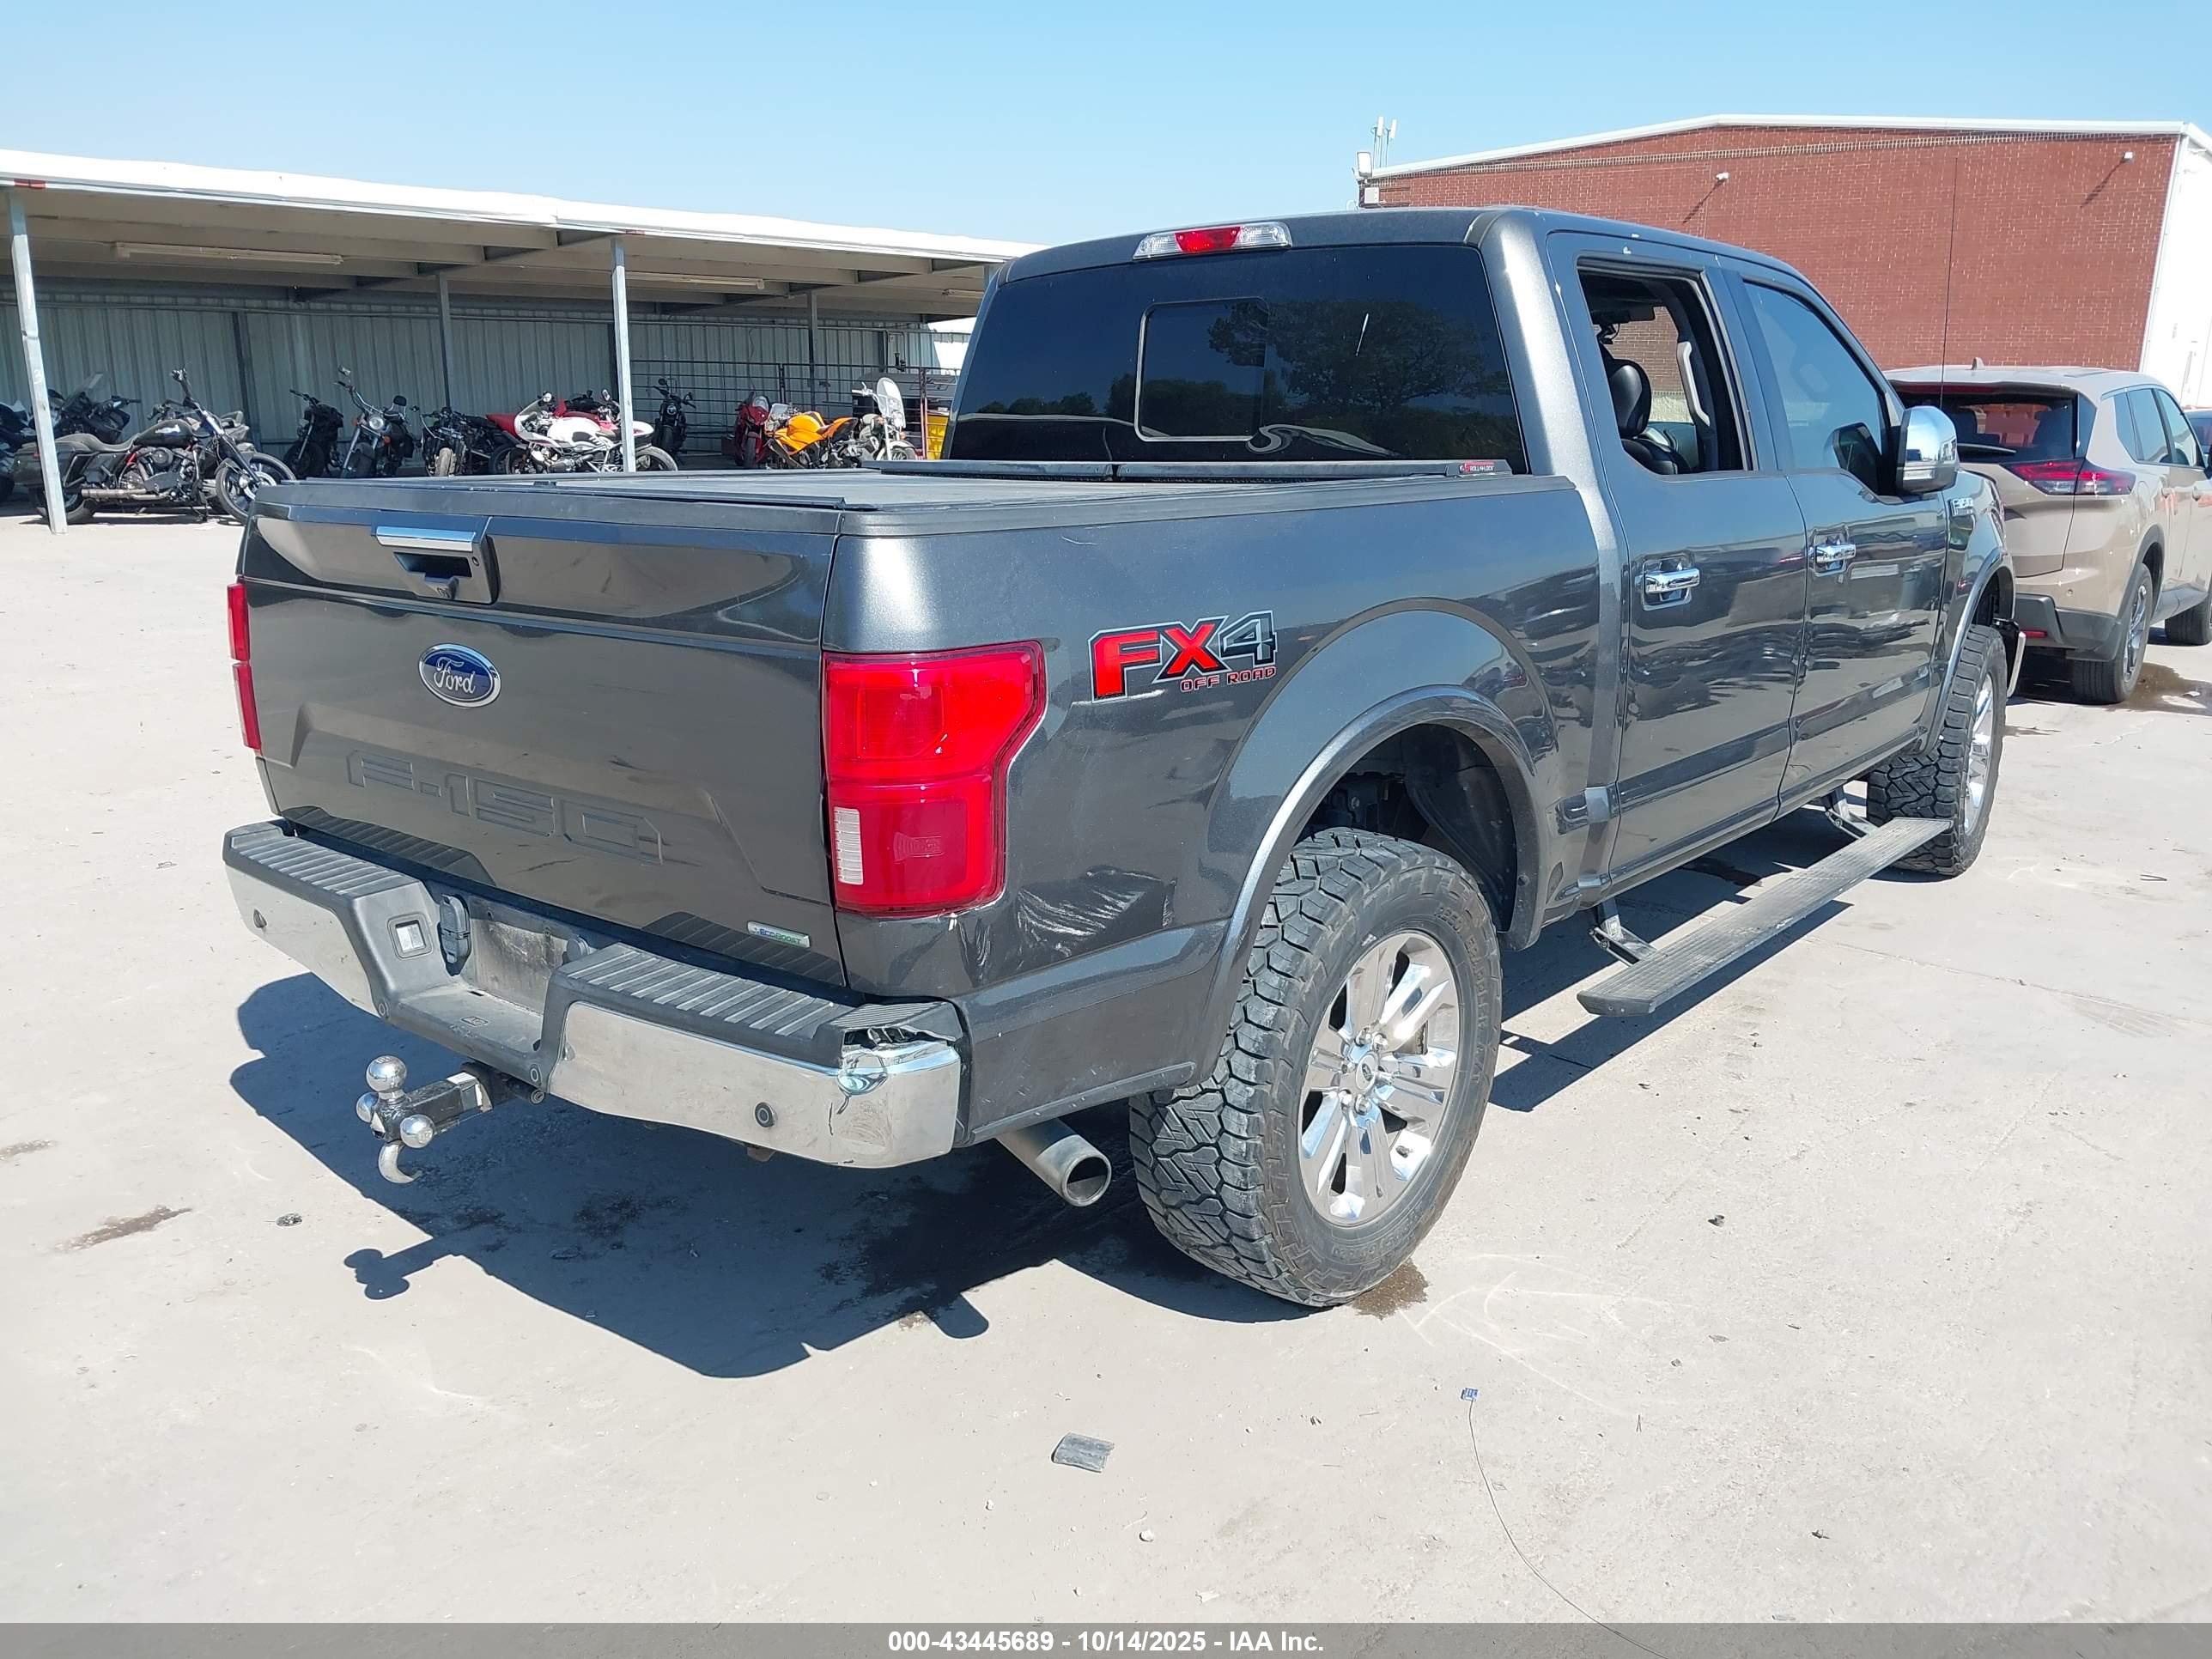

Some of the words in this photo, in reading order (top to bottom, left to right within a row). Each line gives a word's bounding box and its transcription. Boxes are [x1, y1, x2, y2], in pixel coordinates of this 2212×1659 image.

[433, 656, 477, 694] Ford
[1088, 610, 1278, 703] FX4
[1181, 678, 1220, 692] OFF
[1228, 665, 1277, 684] ROAD
[348, 750, 664, 866] F-150
